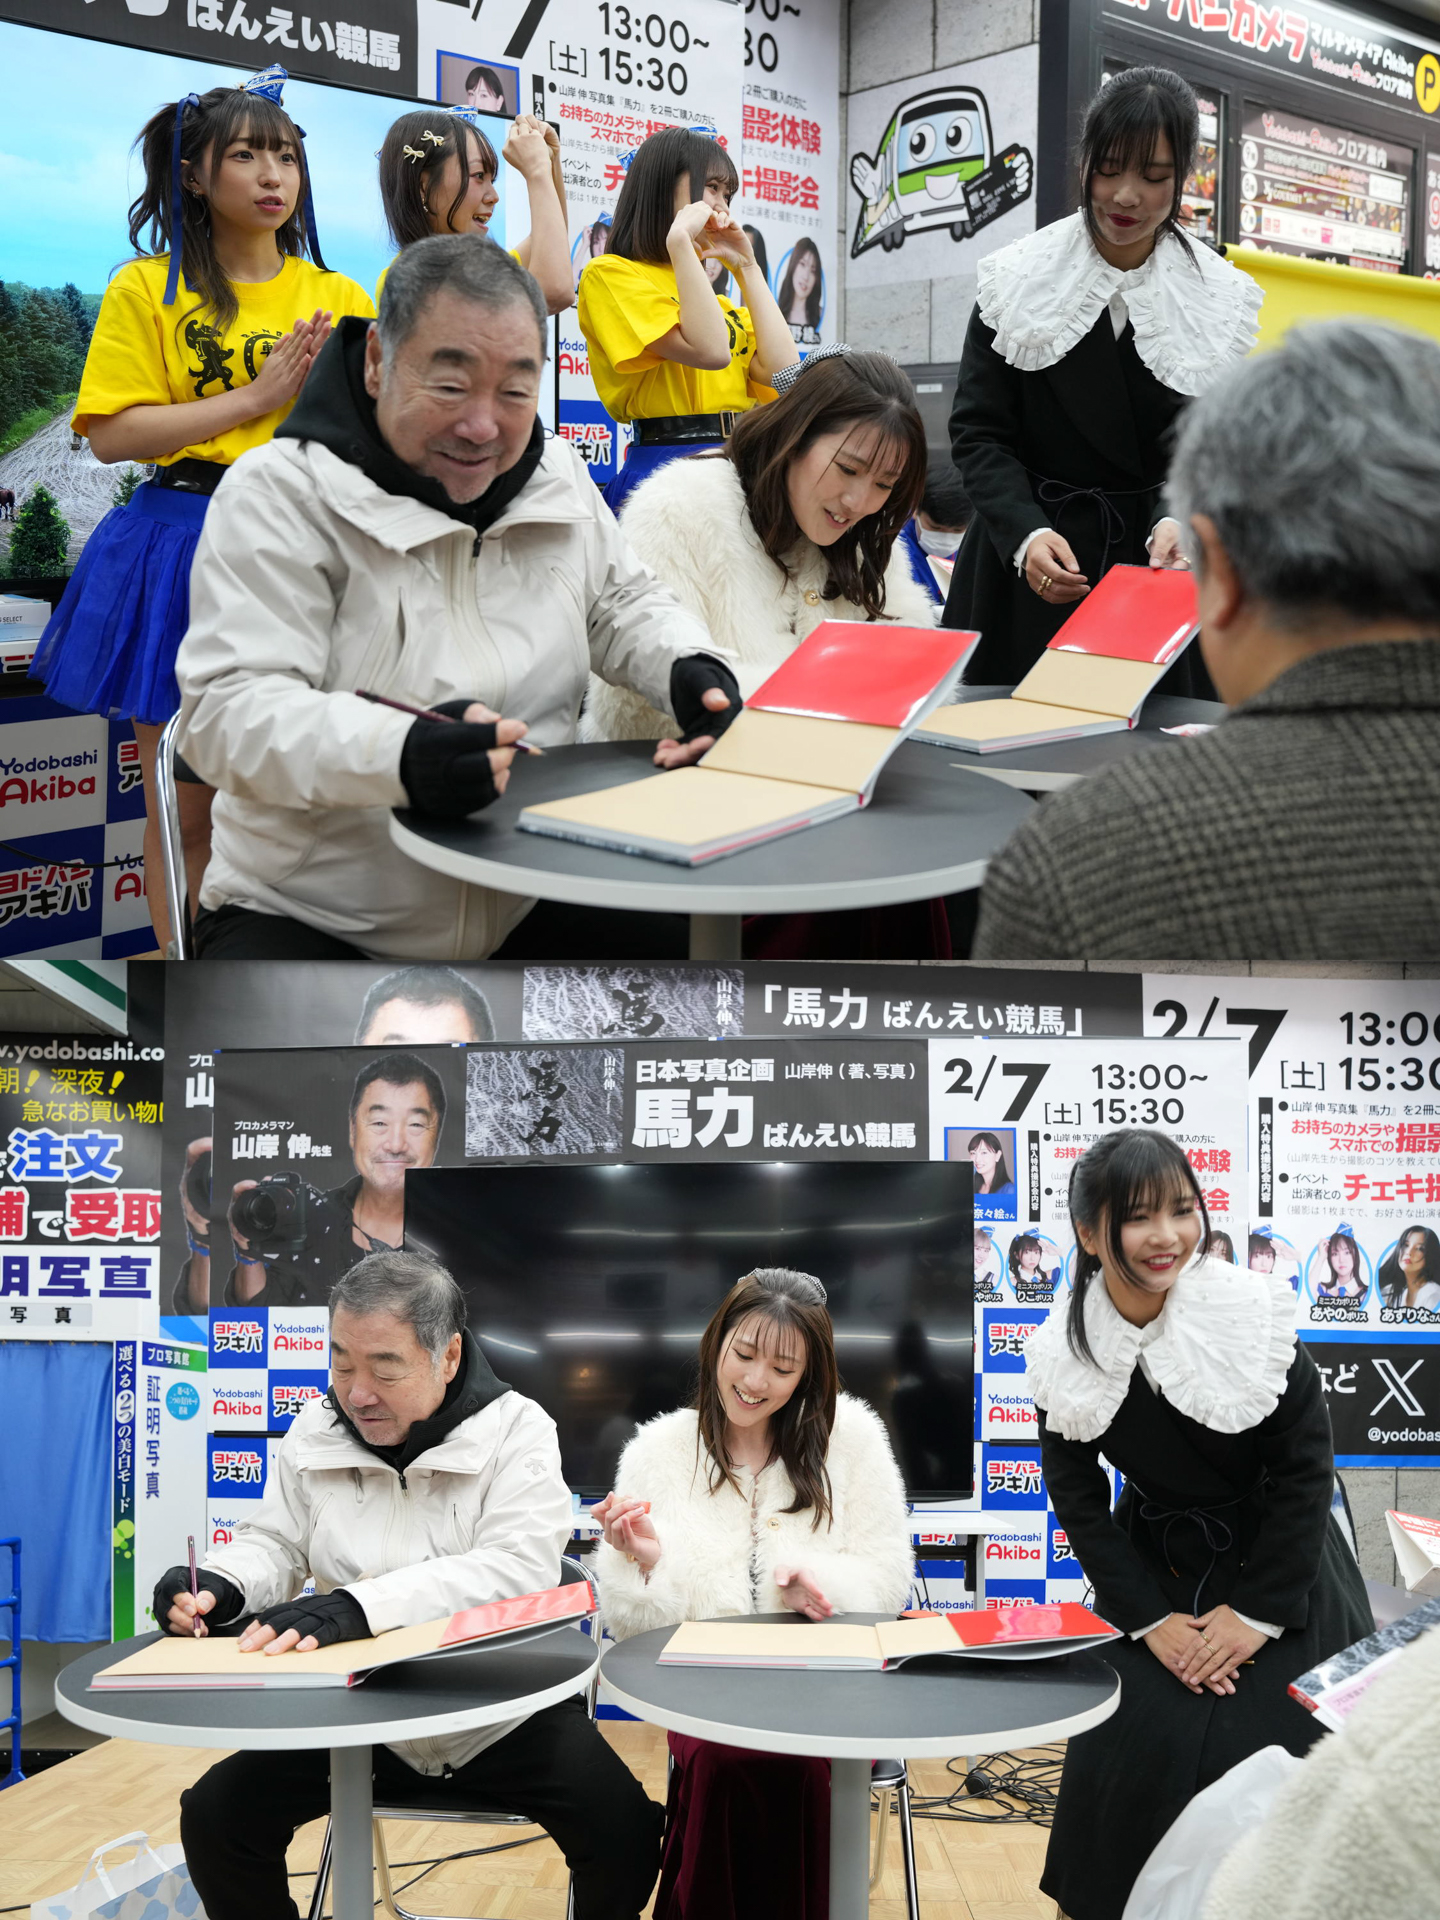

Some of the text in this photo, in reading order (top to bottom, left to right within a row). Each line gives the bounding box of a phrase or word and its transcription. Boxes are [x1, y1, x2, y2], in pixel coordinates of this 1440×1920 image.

[187, 0, 401, 72] ばんえい競馬
[599, 3, 710, 53] 13:00~
[599, 47, 688, 96] 15:30
[0, 750, 98, 775] Yodobashi
[0, 776, 96, 807] Akiba
[764, 984, 1083, 1037] 「馬力 ばんえい競馬」
[1339, 1011, 1440, 1047] 13:0
[636, 1058, 774, 1083] 日本写真企画
[1091, 1064, 1208, 1090] 13:00~
[944, 1055, 1051, 1122] 2/7
[22, 1101, 163, 1123] 急なお買い物
[632, 1086, 754, 1149] 馬力
[763, 1122, 917, 1149] ばんえい競馬
[1092, 1098, 1184, 1125] 15:30
[234, 1121, 295, 1131] プロカメラマン
[1291, 1119, 1395, 1138] お持ちのカメラや
[232, 1134, 280, 1160] 山岸
[1329, 1138, 1394, 1153] スマホでの
[1292, 1173, 1329, 1185] イベント
[1292, 1188, 1341, 1200] 出演者との
[1017, 1291, 1054, 1303] りこポリス
[1311, 1306, 1368, 1321] あやのポリス
[215, 1324, 262, 1335] ヨドバシ
[274, 1324, 325, 1333] Yodobashi
[216, 1336, 261, 1351] アキバ
[274, 1335, 324, 1351] Akiba
[147, 1347, 190, 1367] プロ写真館
[213, 1388, 263, 1398] Yodobashi
[213, 1400, 262, 1415] Akiba
[146, 1375, 160, 1499] 証明写真
[215, 1453, 262, 1464] ヨドバシ
[215, 1466, 260, 1481] アキバ
[989, 1463, 1041, 1474] ヨドバシ
[989, 1476, 1039, 1492] アキバ
[986, 1543, 1041, 1560] Akiba
